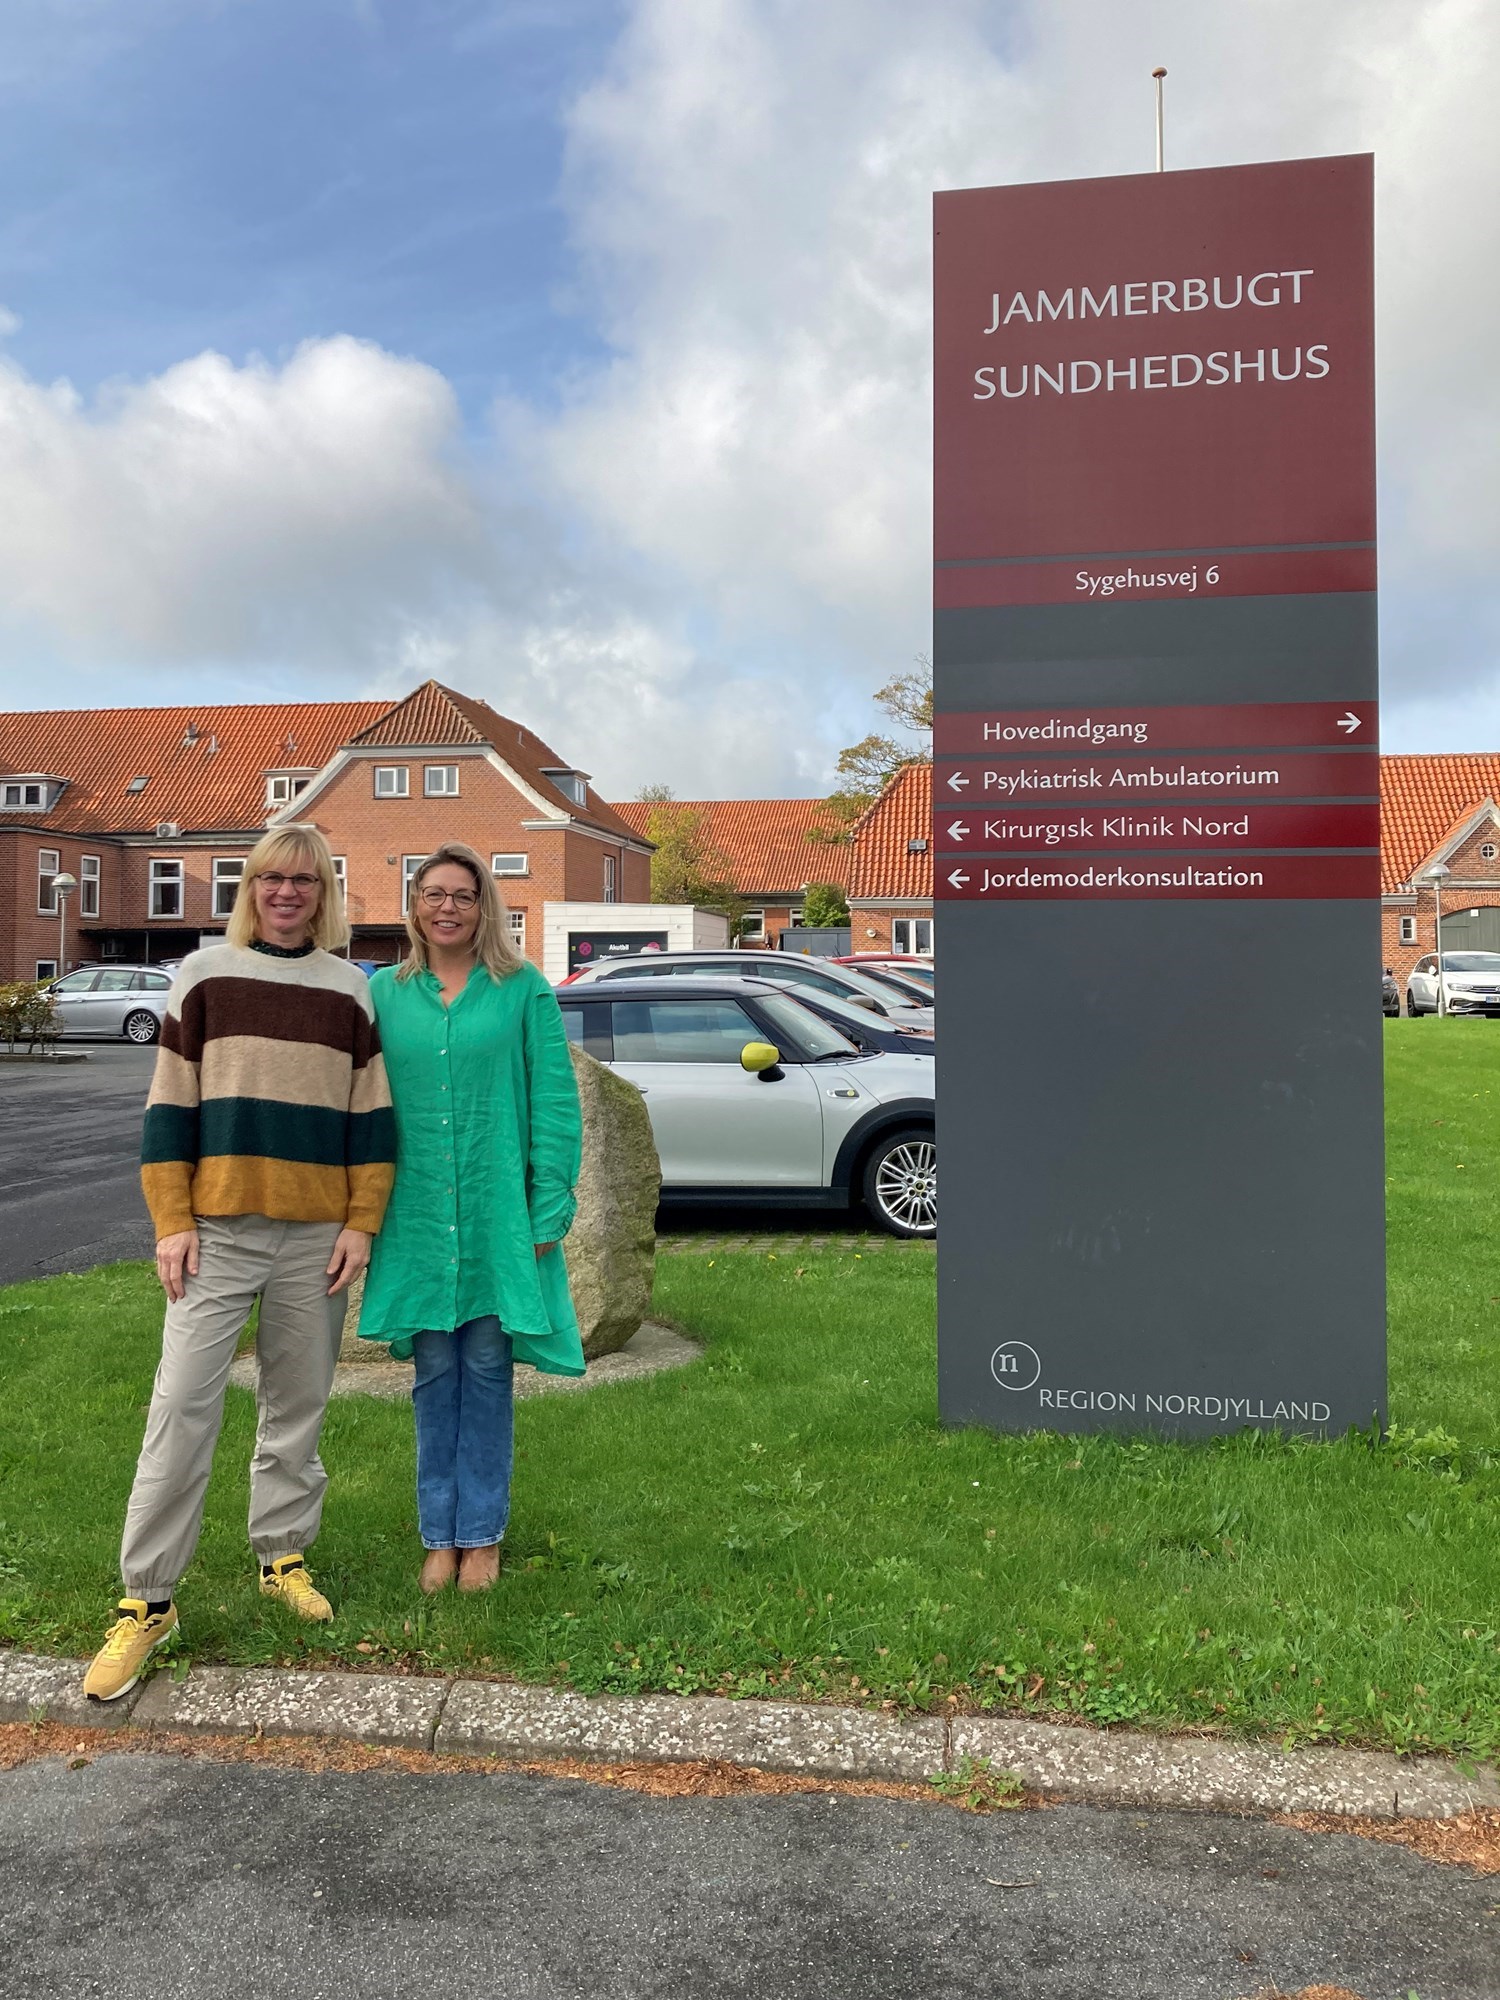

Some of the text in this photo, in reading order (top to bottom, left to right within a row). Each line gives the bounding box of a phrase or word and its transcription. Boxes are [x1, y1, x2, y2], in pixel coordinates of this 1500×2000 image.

[983, 269, 1315, 335] JAMMERBUGT
[973, 344, 1330, 400] SUNDHEDSHUS
[1075, 565, 1220, 596] Sygehusvej 6
[983, 718, 1148, 744] Hovedindgang
[984, 764, 1280, 795] Psykiatrisk Ambulatorium
[1102, 815, 1175, 837] Klinik
[1182, 814, 1250, 836] Nord
[979, 865, 1264, 892] Jordemoderkonsultation
[1039, 1388, 1331, 1422] REGION NORDJYLLAND
